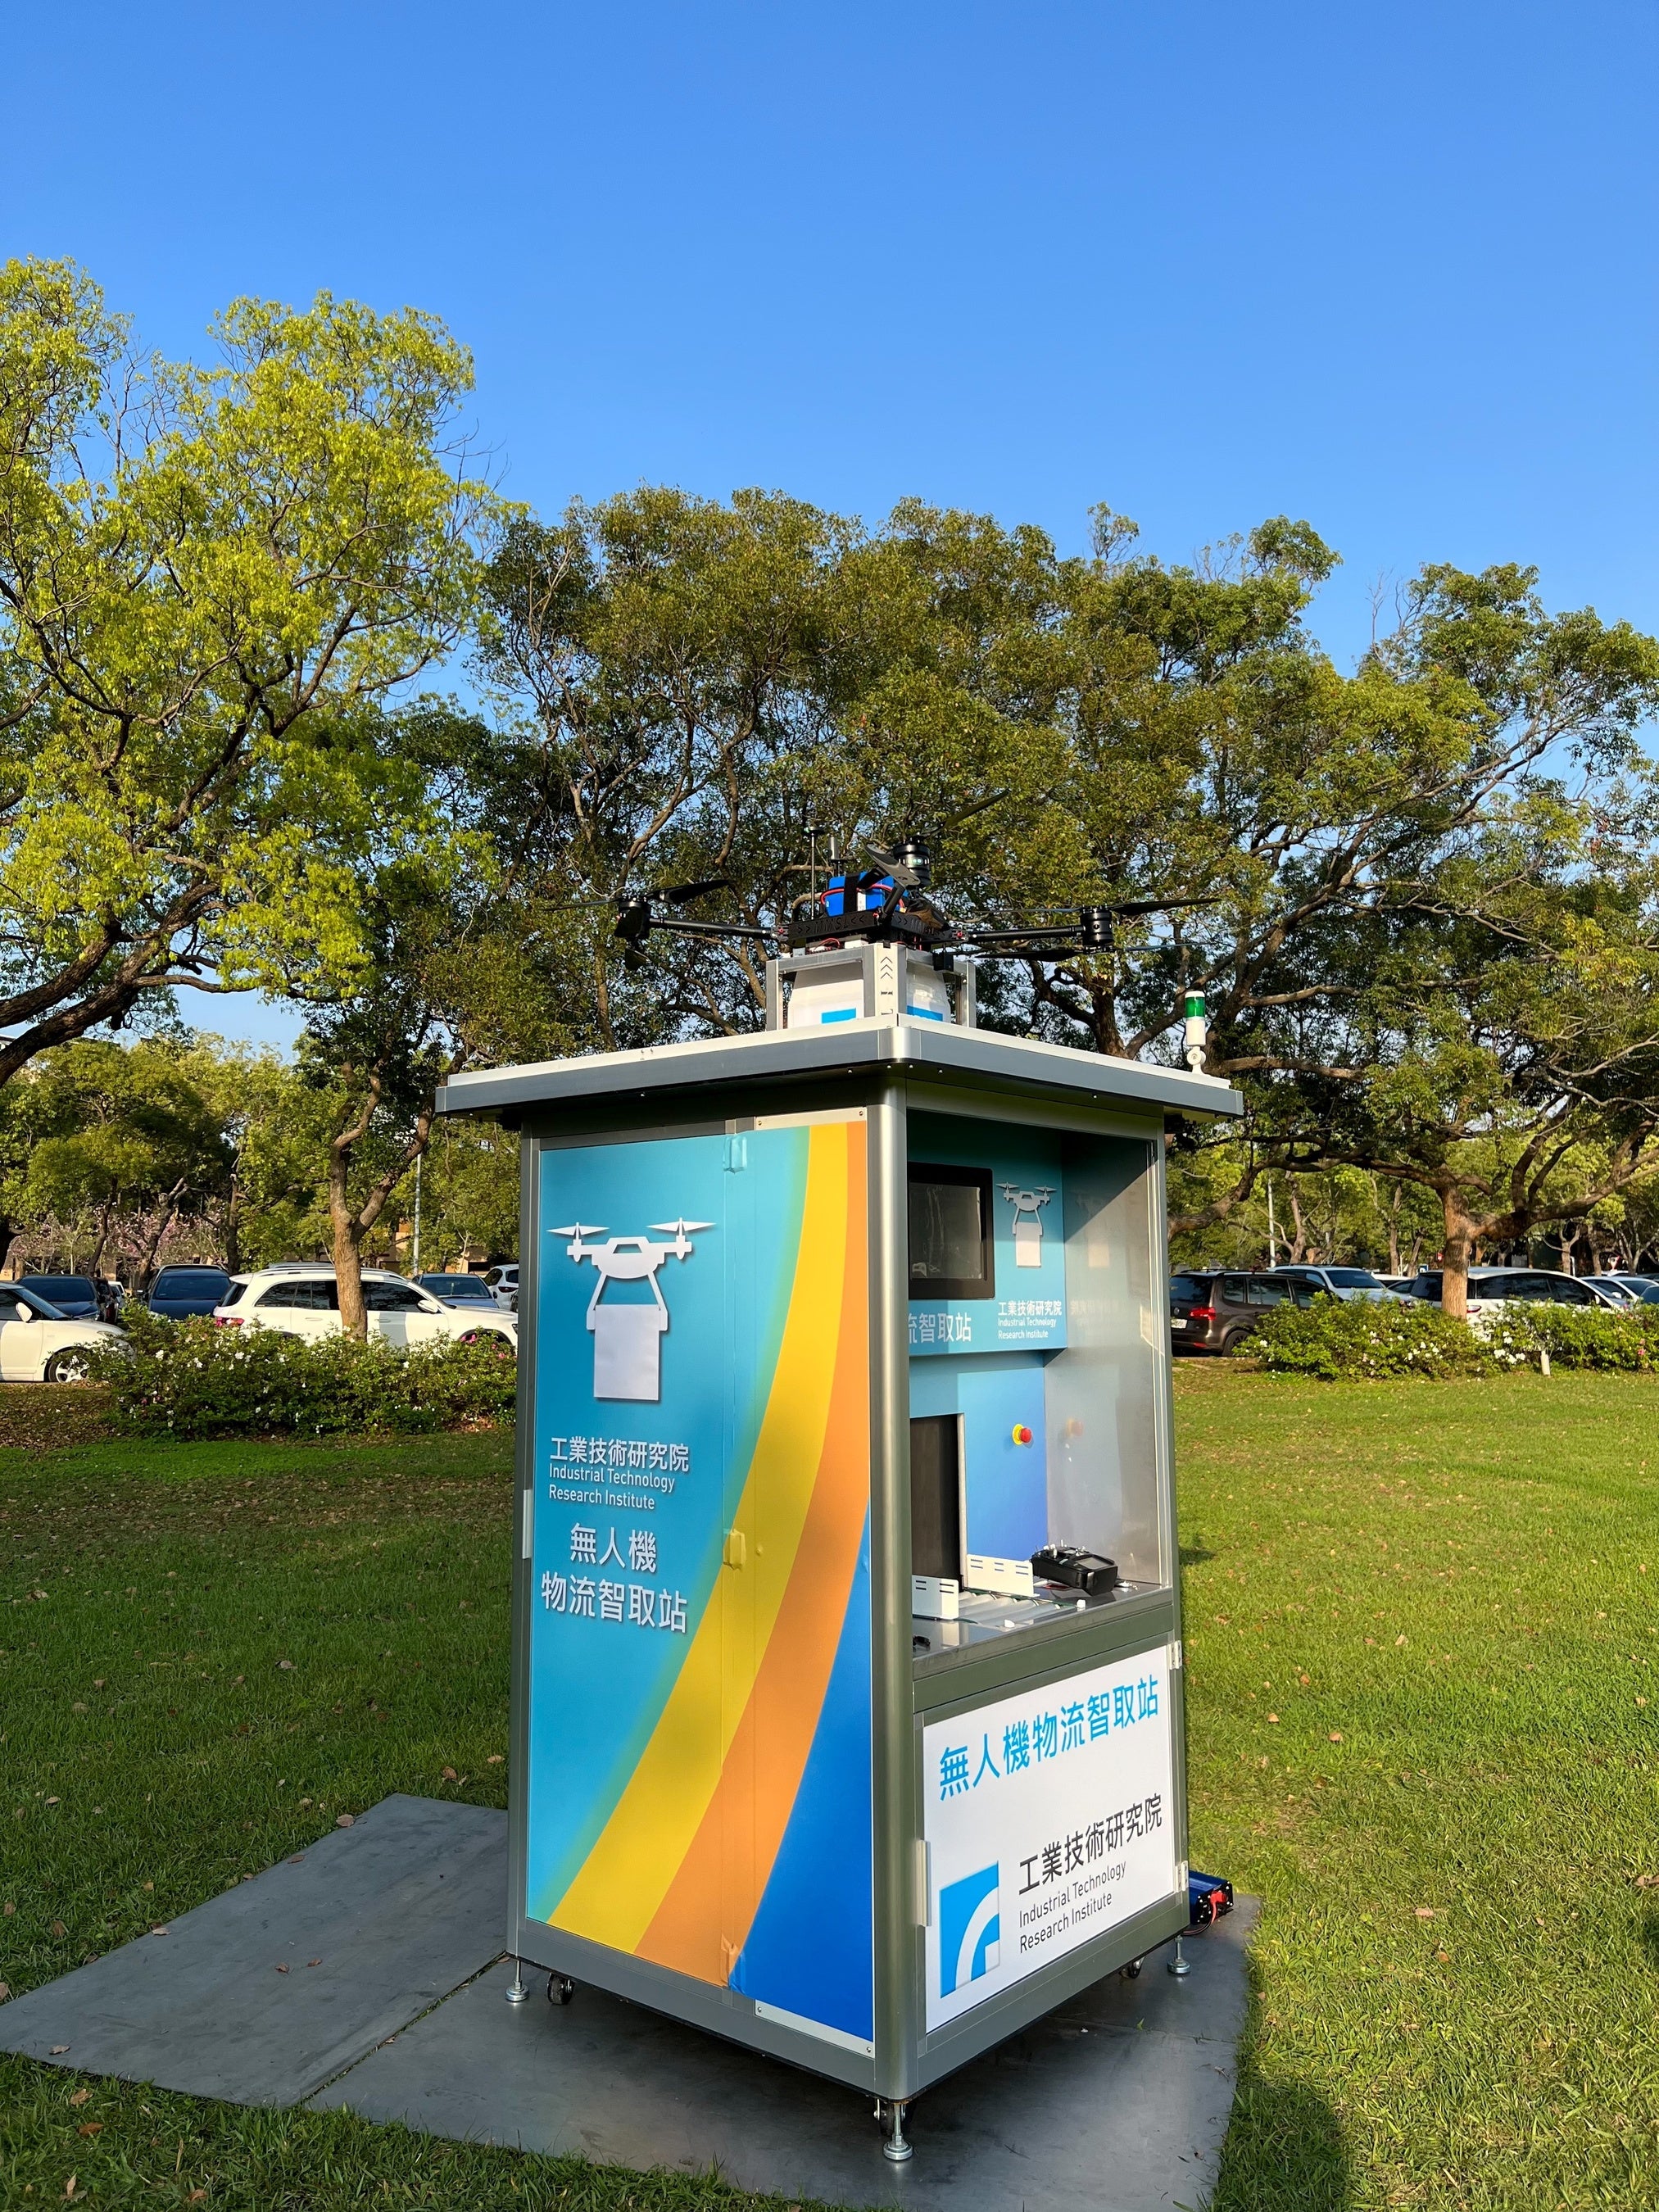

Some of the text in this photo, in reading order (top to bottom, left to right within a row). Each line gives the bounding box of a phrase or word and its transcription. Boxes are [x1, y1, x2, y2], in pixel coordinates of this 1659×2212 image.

[998, 1300, 1062, 1316] 工業技術研究院
[998, 1317, 1057, 1328] Industrial Technology
[998, 1330, 1049, 1339] Research Institute
[550, 1436, 689, 1472] 工業技術研究院
[549, 1463, 675, 1493] Industrial Technology
[549, 1484, 655, 1510] Research Institute
[570, 1522, 656, 1572] 無人機
[541, 1571, 687, 1633] 物流智取站
[940, 1675, 1158, 1801] 無人機物流智取站
[1018, 1793, 1163, 1896] 工業技術研究院
[1019, 1861, 1126, 1929] Industrial Technology
[1019, 1892, 1113, 1954] Research Institute
